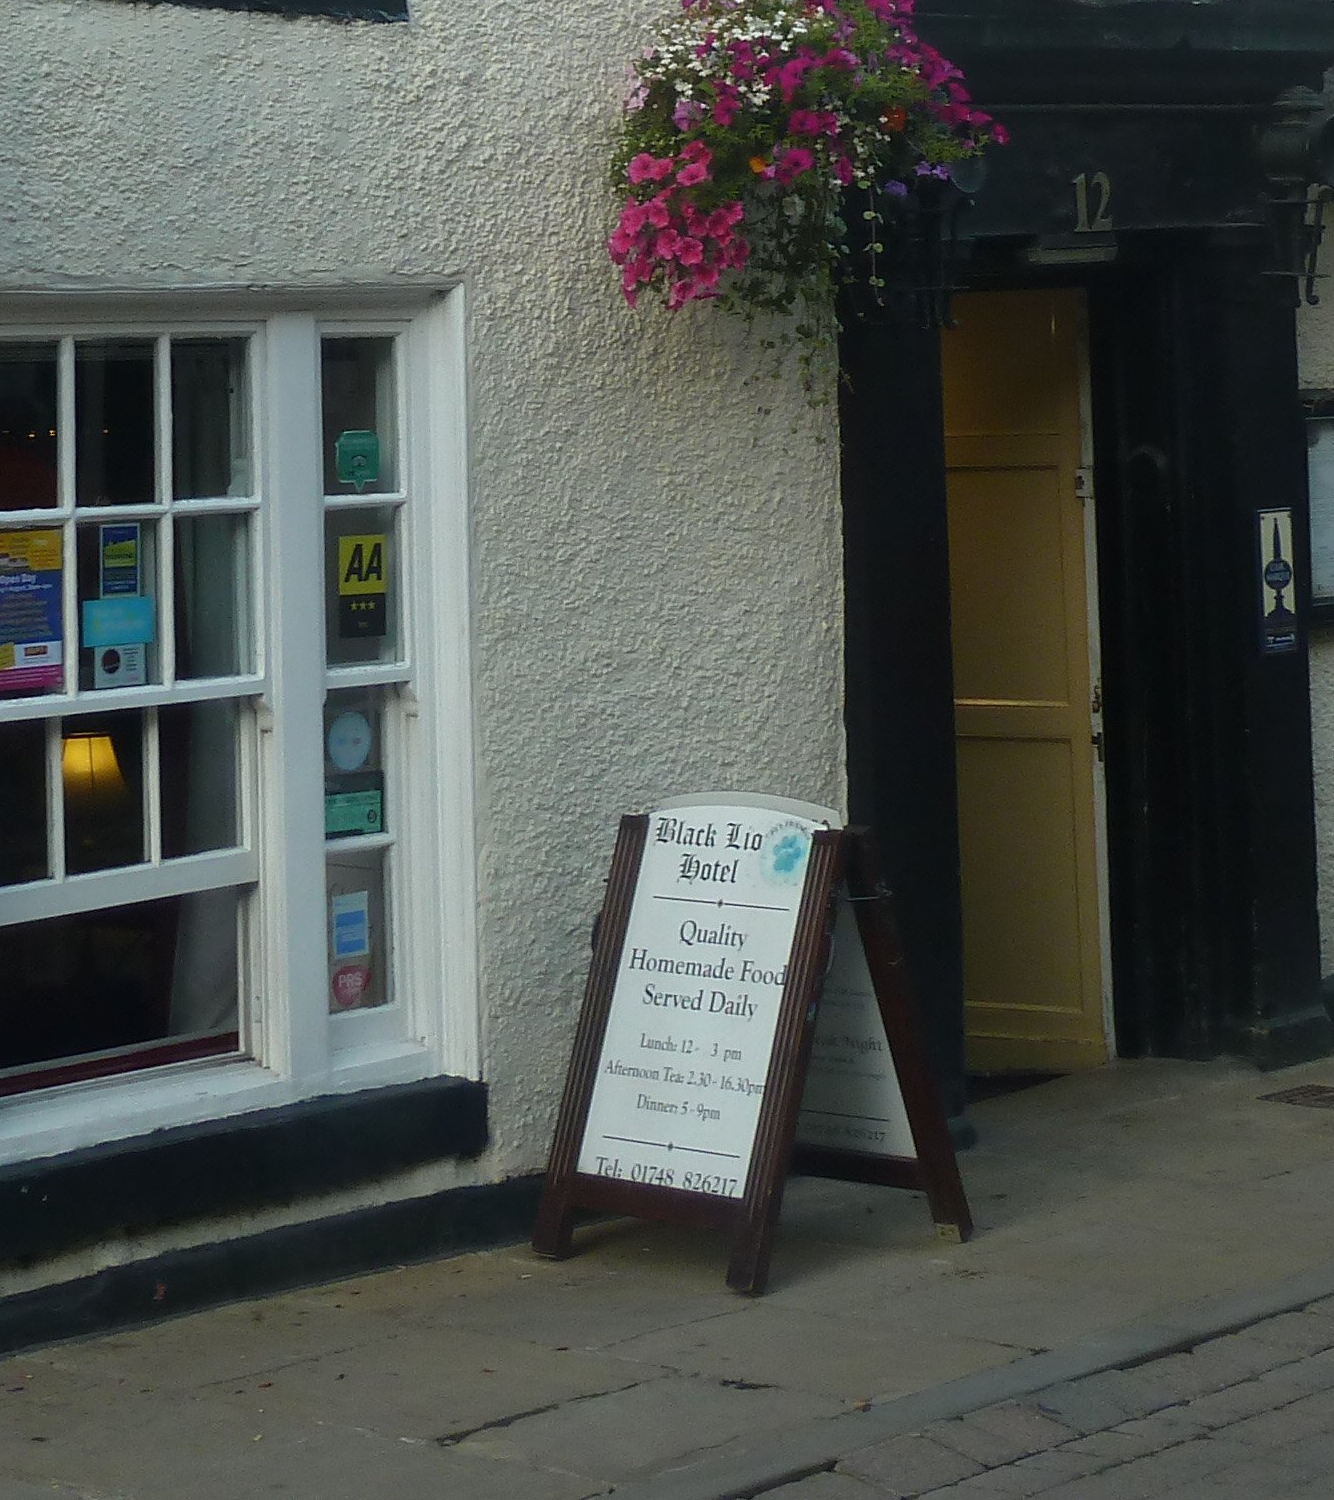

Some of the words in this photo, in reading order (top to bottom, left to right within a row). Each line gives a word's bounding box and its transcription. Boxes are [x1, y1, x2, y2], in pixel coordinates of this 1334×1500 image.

[1072, 171, 1113, 232] 12
[344, 543, 383, 583] AA
[653, 817, 717, 848] Black
[725, 822, 763, 851] Lio
[677, 853, 740, 885] Hotel
[680, 920, 749, 950] Quality
[629, 948, 734, 980] Homemade
[740, 959, 788, 986] Food
[642, 983, 703, 1011] Served
[709, 991, 758, 1021] Daily
[640, 1033, 677, 1052] Lunch:
[710, 1043, 719, 1057] 3
[723, 1048, 742, 1062] pm
[604, 1059, 659, 1080] Afternoon
[663, 1066, 684, 1083] Tea:
[637, 1093, 678, 1115] Dinner:
[596, 1156, 623, 1178] Tel:
[631, 1163, 675, 1186] 01748
[682, 1171, 738, 1199] 826217
